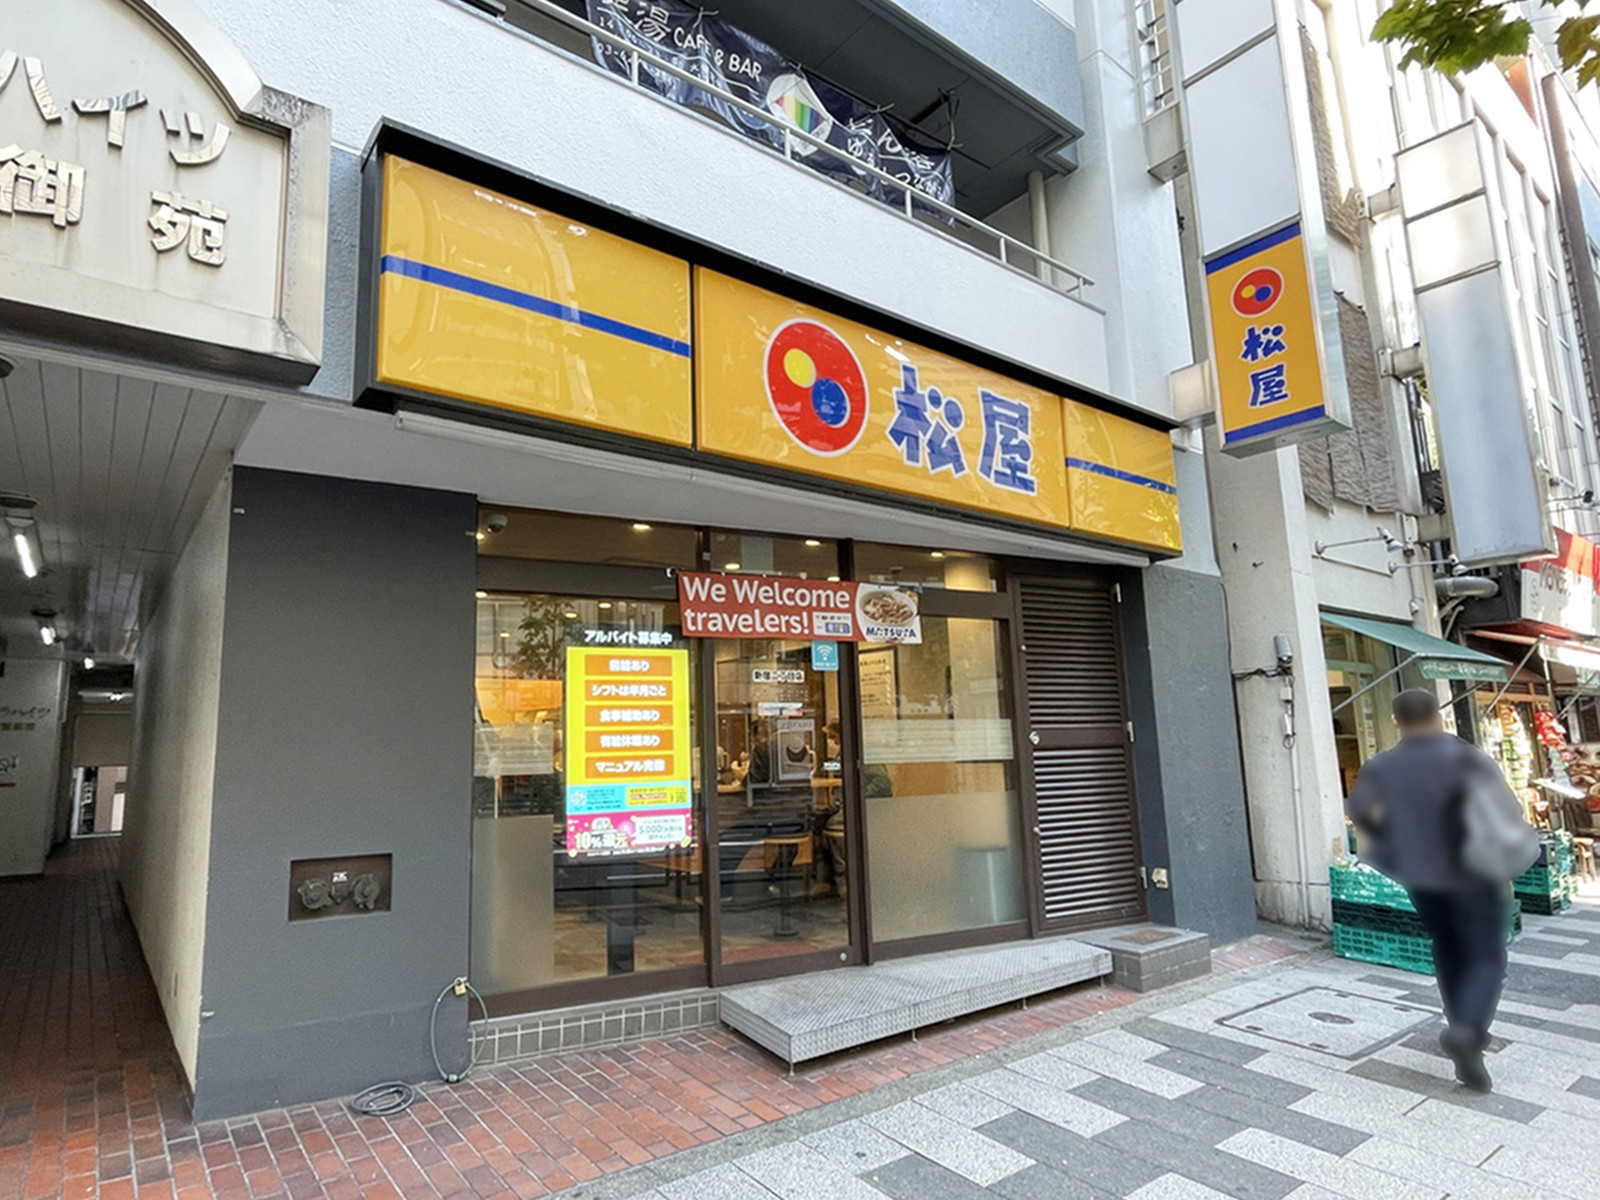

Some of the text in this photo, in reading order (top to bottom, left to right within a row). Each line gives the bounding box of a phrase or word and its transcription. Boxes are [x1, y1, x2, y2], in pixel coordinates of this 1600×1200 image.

[673, 26, 712, 57] CAFE
[714, 49, 724, 67] &
[728, 53, 762, 83] BAR
[0, 144, 229, 267] 御苑
[1240, 324, 1289, 409] 松屋
[885, 362, 1037, 497] 松屋
[682, 575, 851, 609] We Welcome
[584, 630, 673, 645] アルバイト募集中
[684, 608, 810, 635] travelers!
